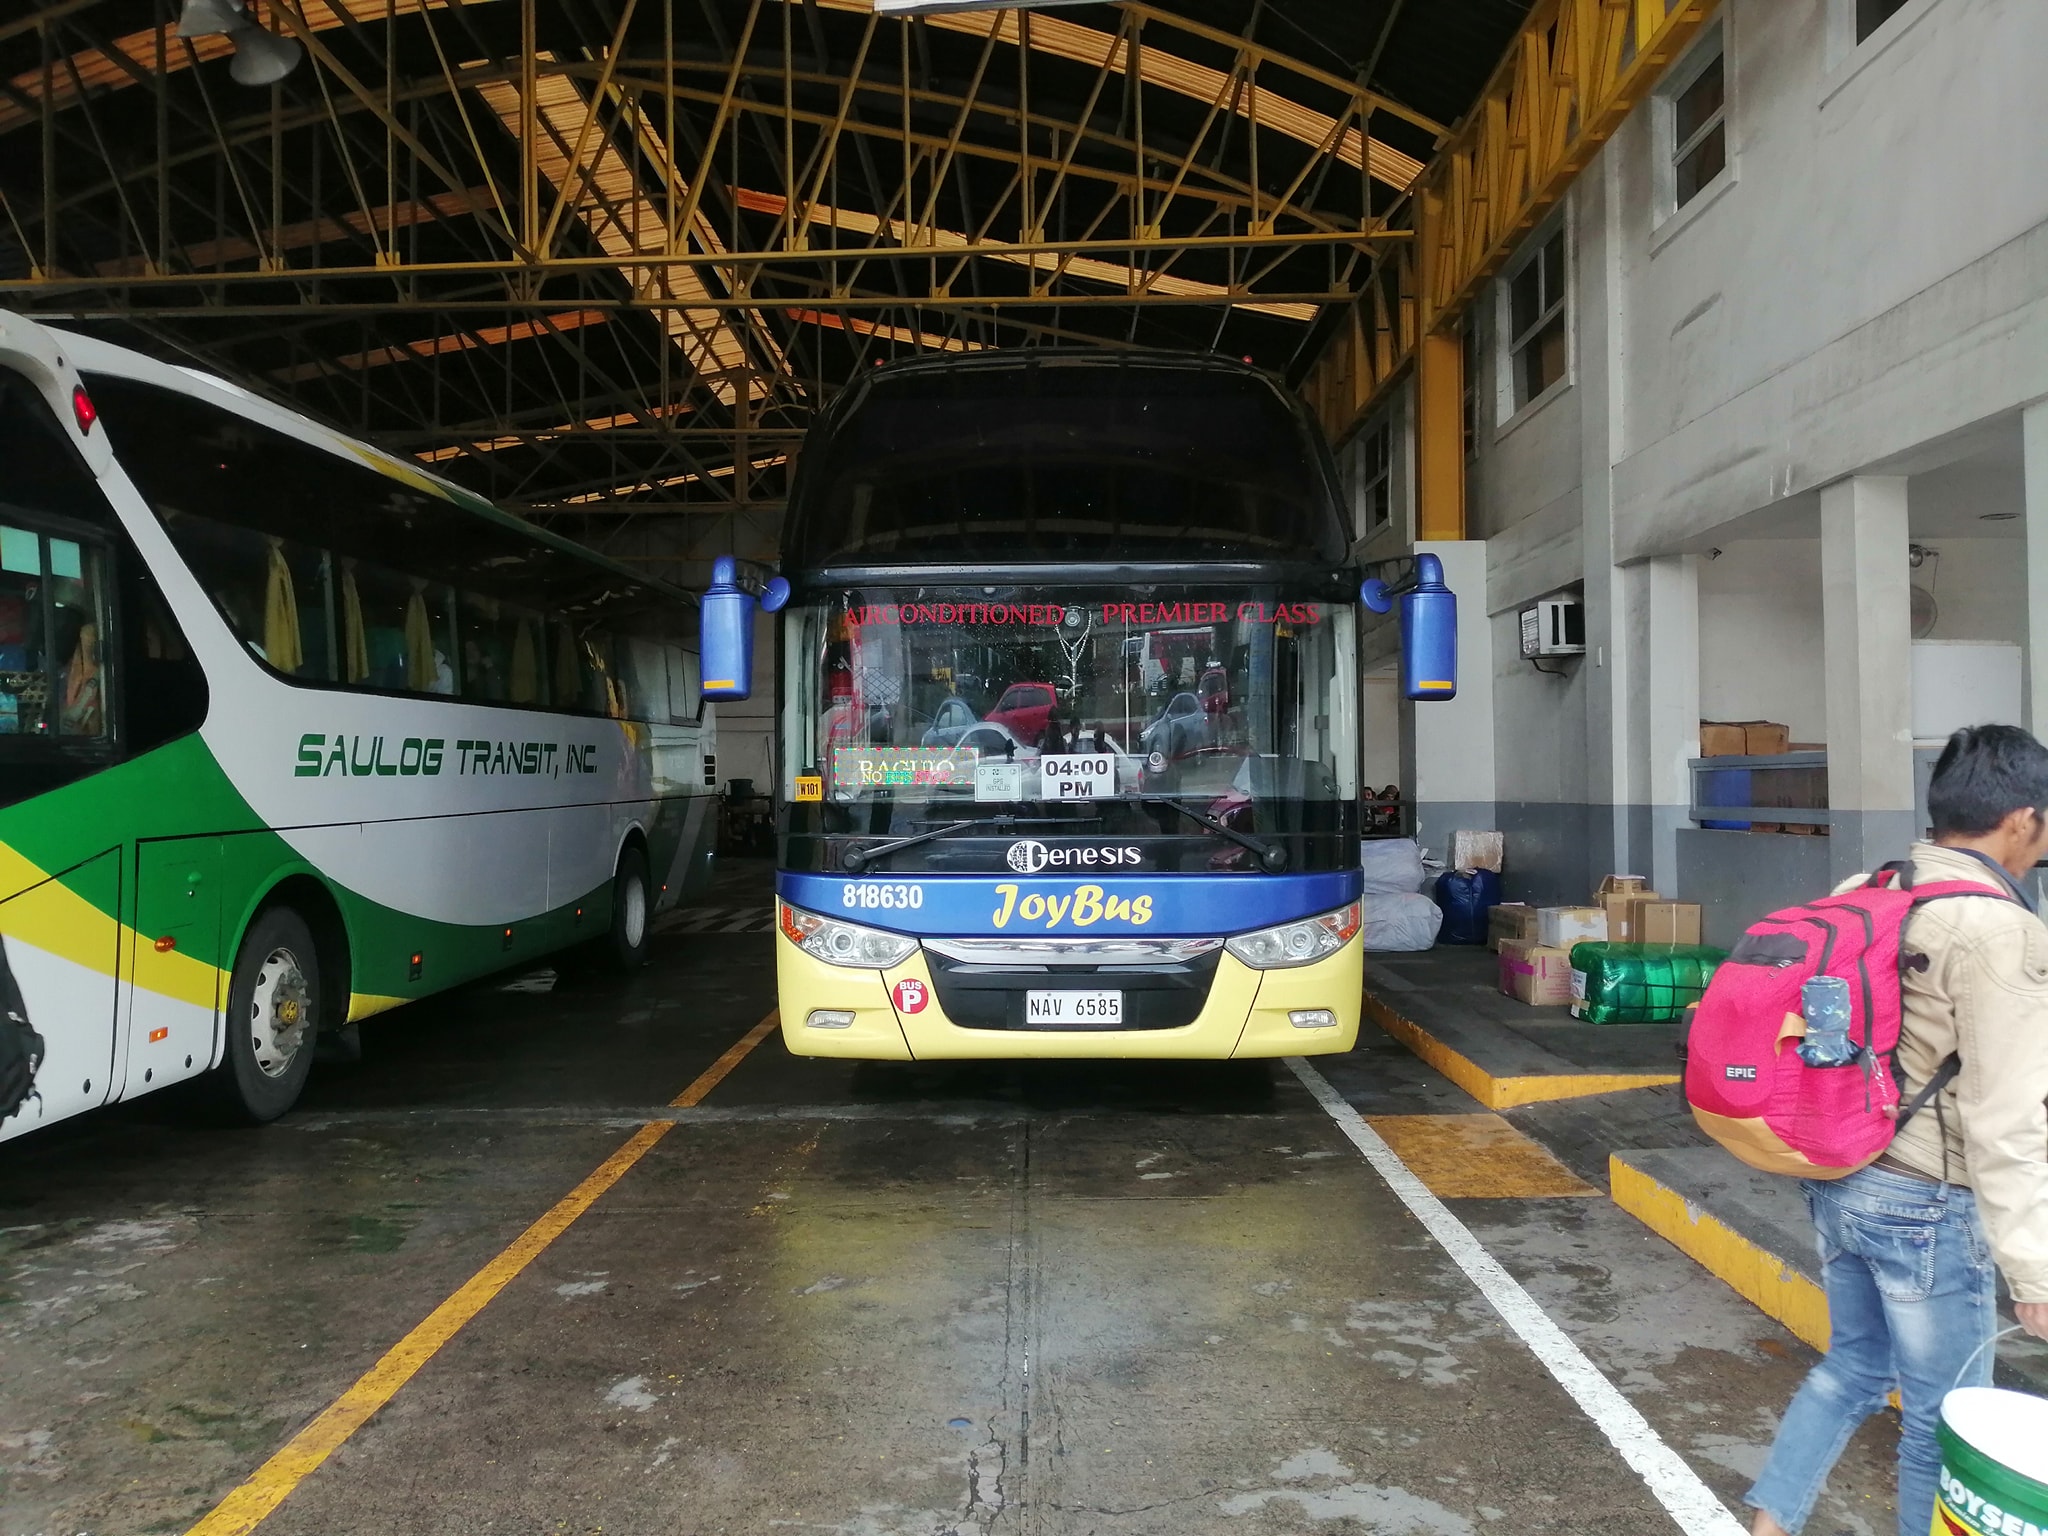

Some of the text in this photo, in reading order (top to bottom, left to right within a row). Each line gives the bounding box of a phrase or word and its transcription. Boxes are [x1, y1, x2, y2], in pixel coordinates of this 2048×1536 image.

[842, 602, 1321, 627] AIRCONDITIONED PREMIER CLASS
[294, 733, 598, 780] SAULOG TRANSIT, INC.
[861, 771, 882, 783] NO
[1045, 760, 1108, 776] 04:00
[1059, 781, 1093, 797] PM
[842, 884, 923, 909] 818630
[992, 884, 1153, 929] JoyBus
[899, 981, 922, 990] BUS
[902, 989, 922, 1012] P
[1030, 998, 1119, 1016] NAV 6585
[1726, 1066, 1756, 1078] EPIC
